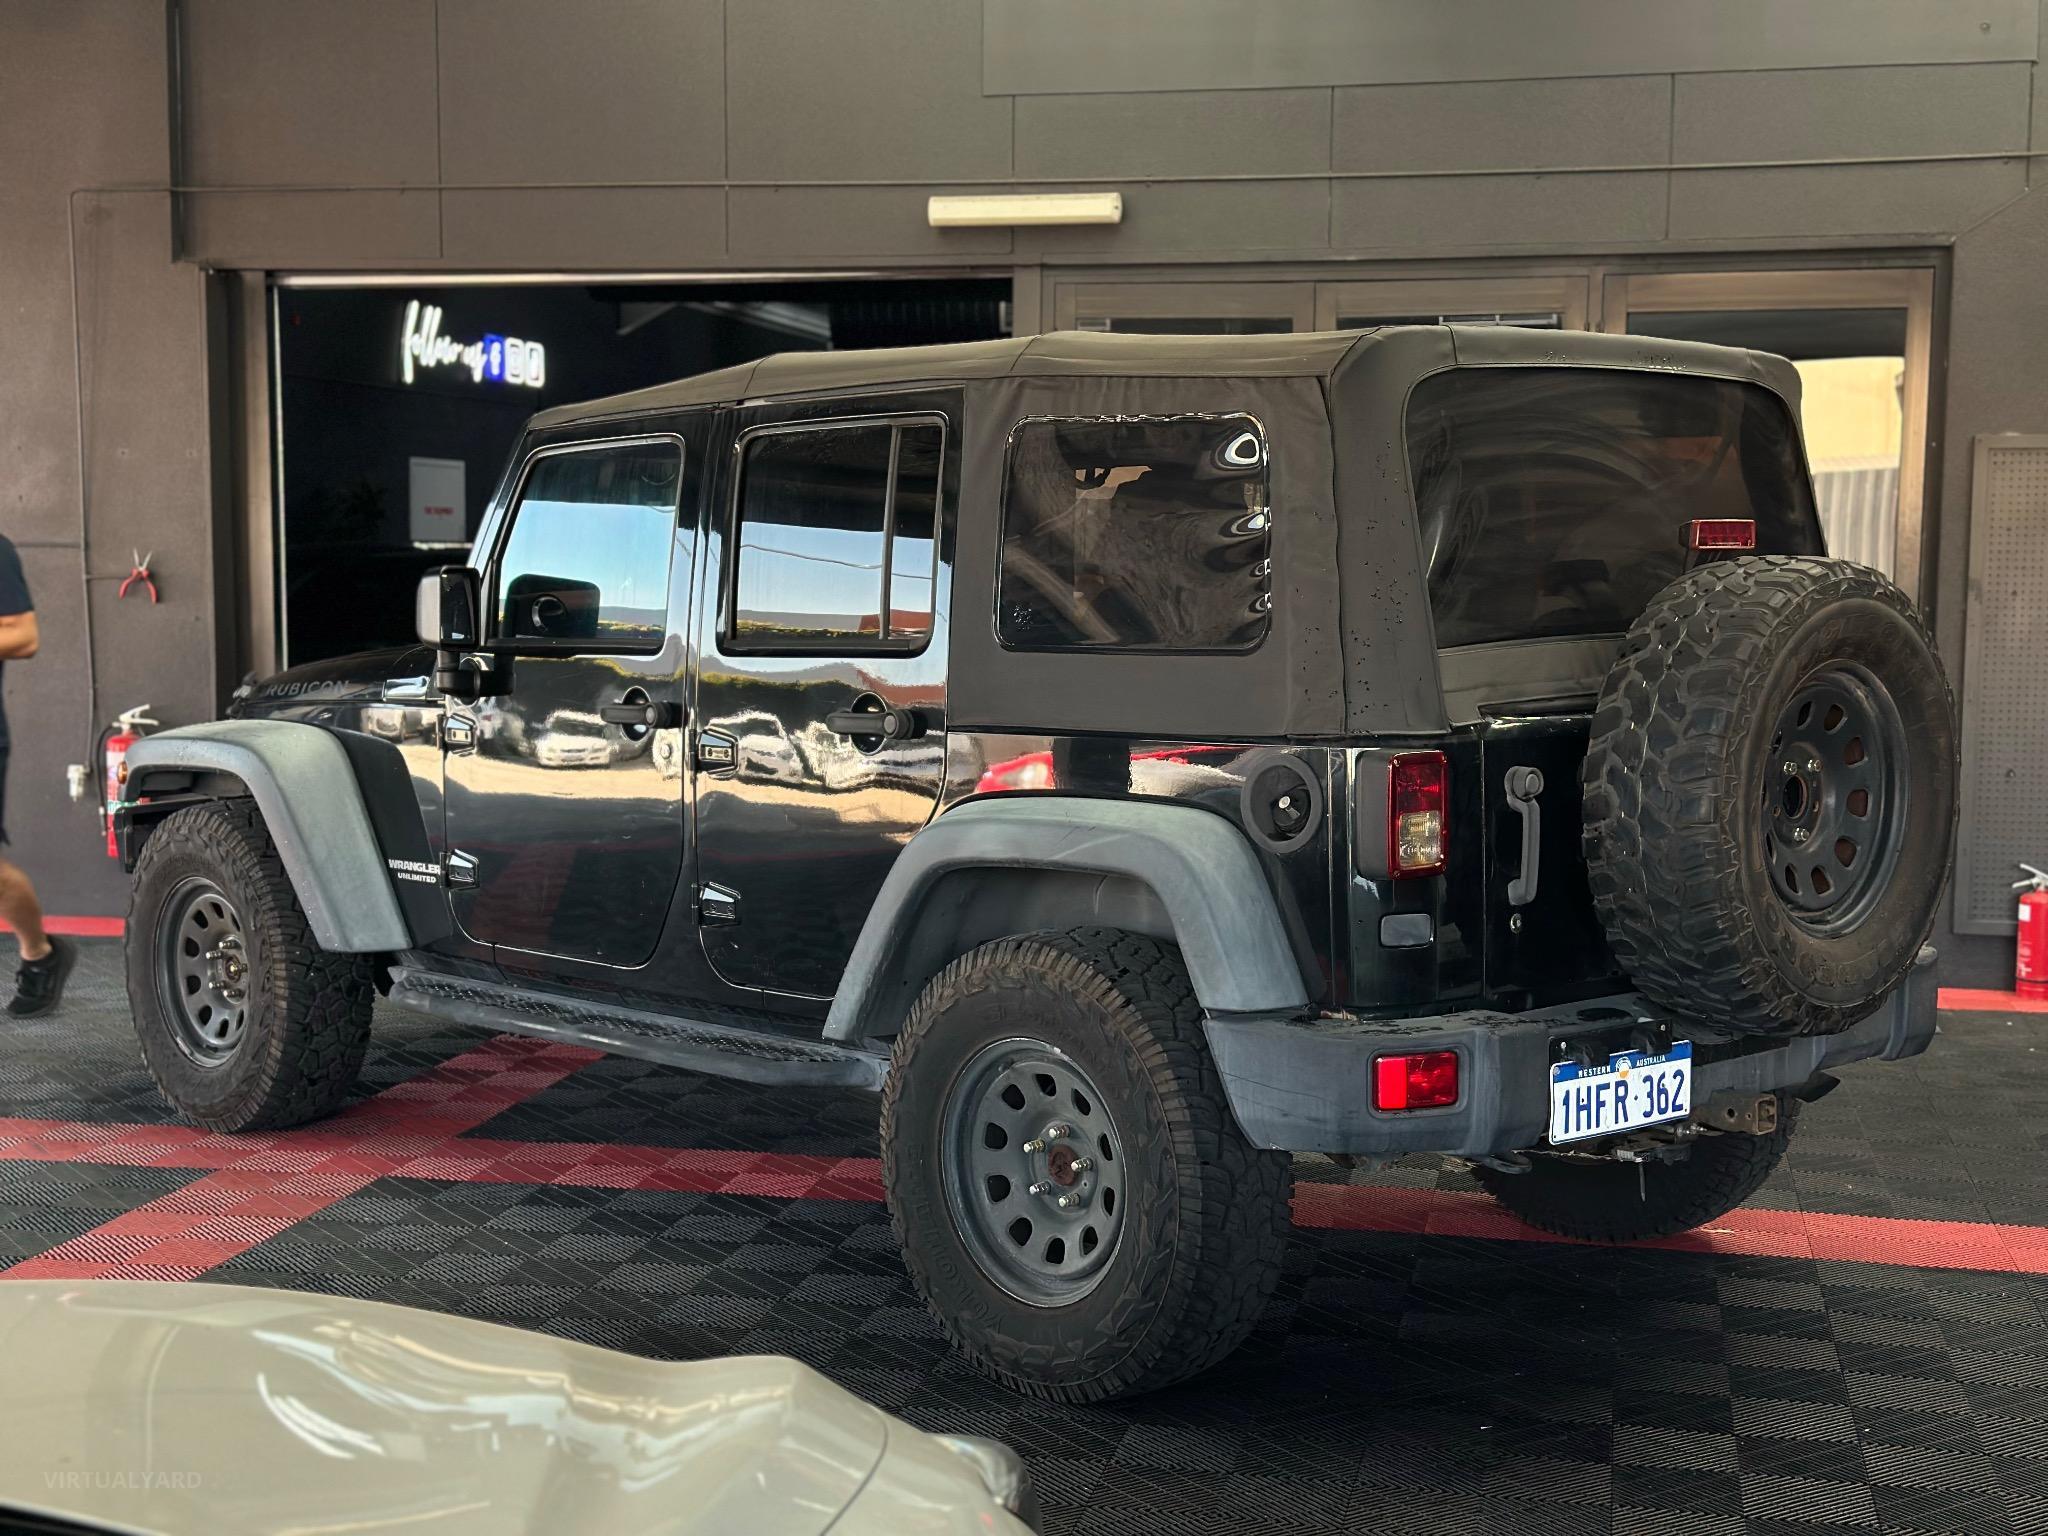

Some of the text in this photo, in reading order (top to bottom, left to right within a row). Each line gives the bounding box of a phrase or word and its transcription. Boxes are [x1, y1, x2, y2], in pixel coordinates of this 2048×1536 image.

[266, 680, 349, 697] RUBICON
[388, 859, 441, 875] WRANGLER
[397, 872, 437, 884] UNLIMITED
[1578, 1054, 1666, 1078] WESTERN AUSTRALIA
